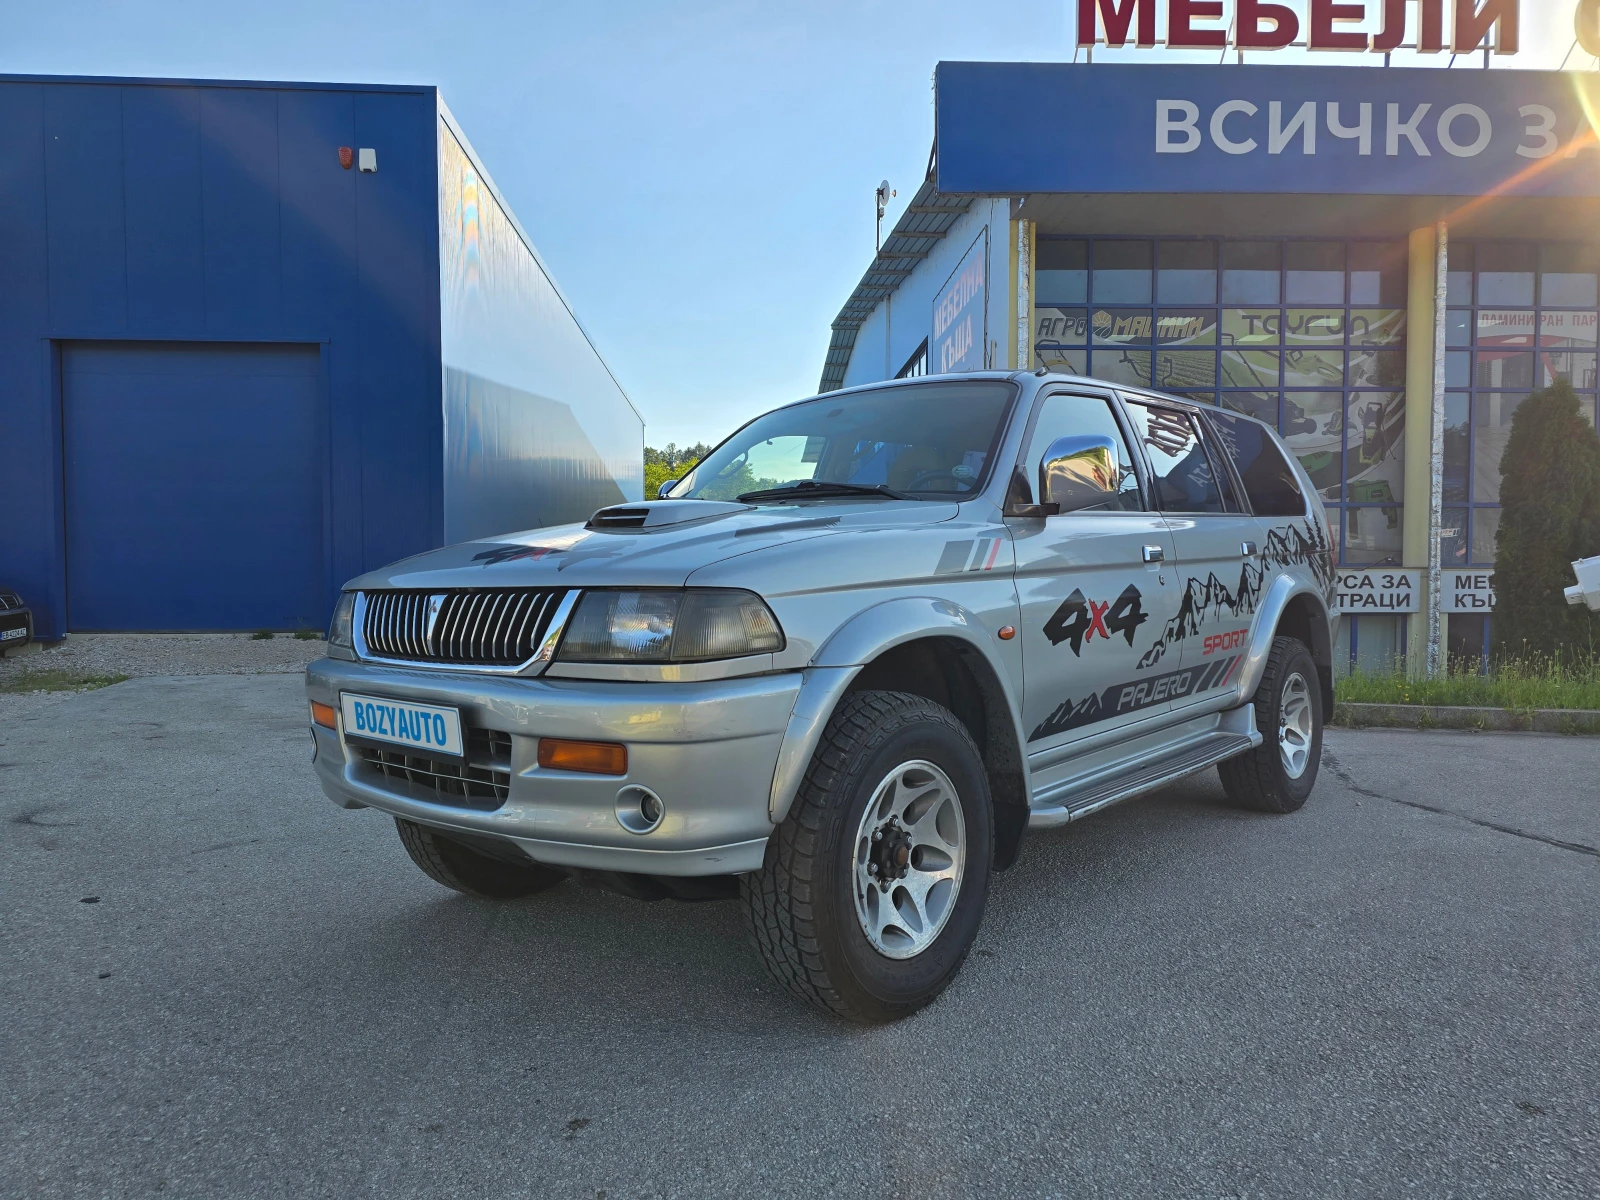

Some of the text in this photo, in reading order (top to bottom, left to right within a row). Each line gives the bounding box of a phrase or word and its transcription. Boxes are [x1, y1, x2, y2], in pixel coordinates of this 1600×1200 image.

[1077, 0, 1519, 55] МЕБЕЛИ
[1155, 99, 1492, 157] ВСИЧКО
[934, 252, 983, 341] МЕБЕЛНА
[1037, 317, 1204, 338] АГРО МАШИНИ
[1482, 314, 1563, 327] ЛАМИНИРАН
[941, 314, 973, 374] КЪЩА
[1381, 574, 1412, 589] ЗА
[1202, 628, 1248, 656] SPORT
[1117, 671, 1192, 710] PAJERO
[354, 701, 446, 746] BOZYAUTO
